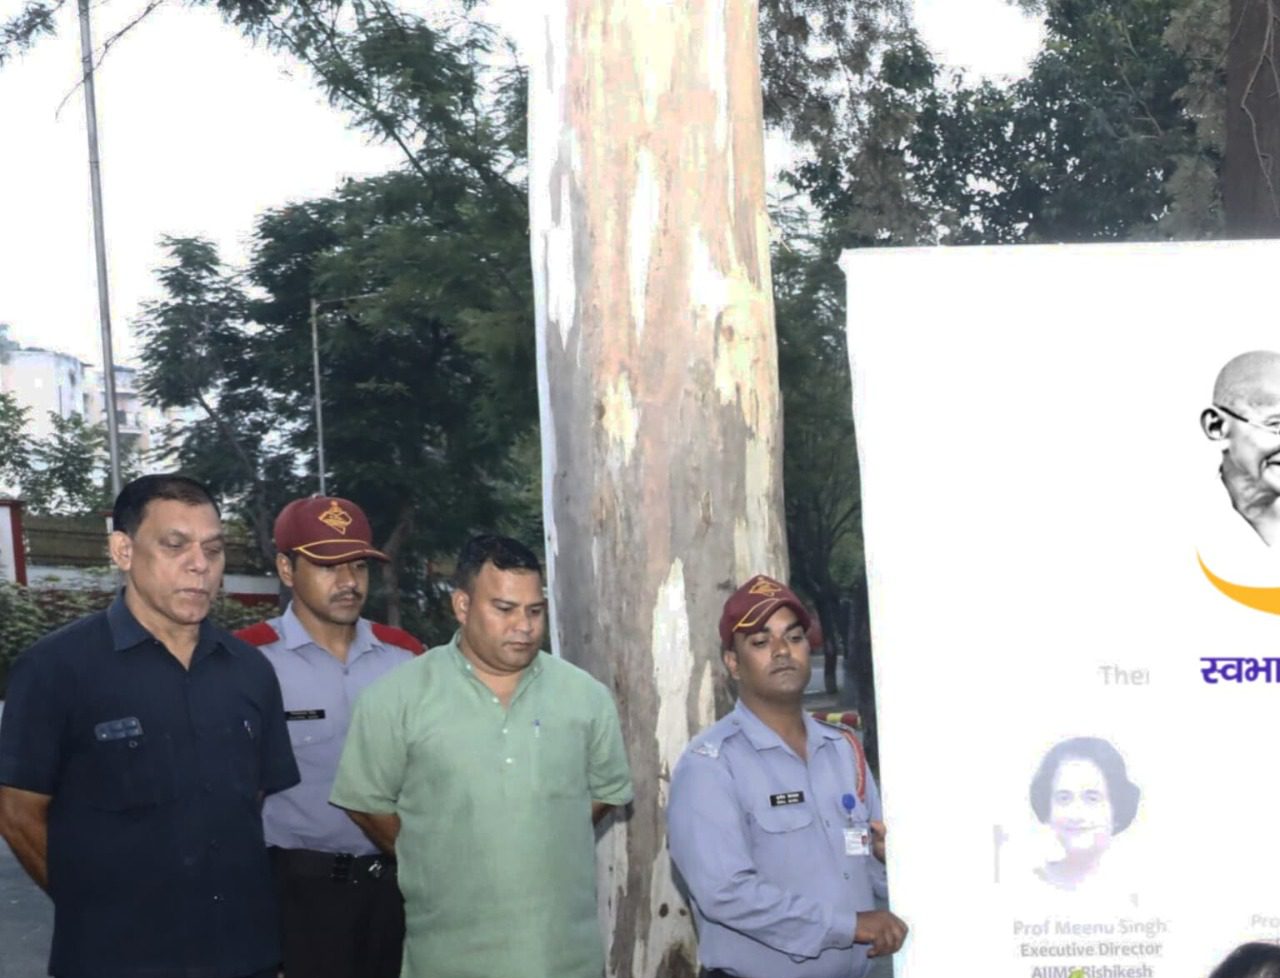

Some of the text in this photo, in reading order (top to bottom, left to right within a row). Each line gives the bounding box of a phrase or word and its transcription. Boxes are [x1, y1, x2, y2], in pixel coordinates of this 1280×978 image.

[1013, 918, 1167, 938] Prof Meenu Singh
[1020, 942, 1163, 957] Executive Director
